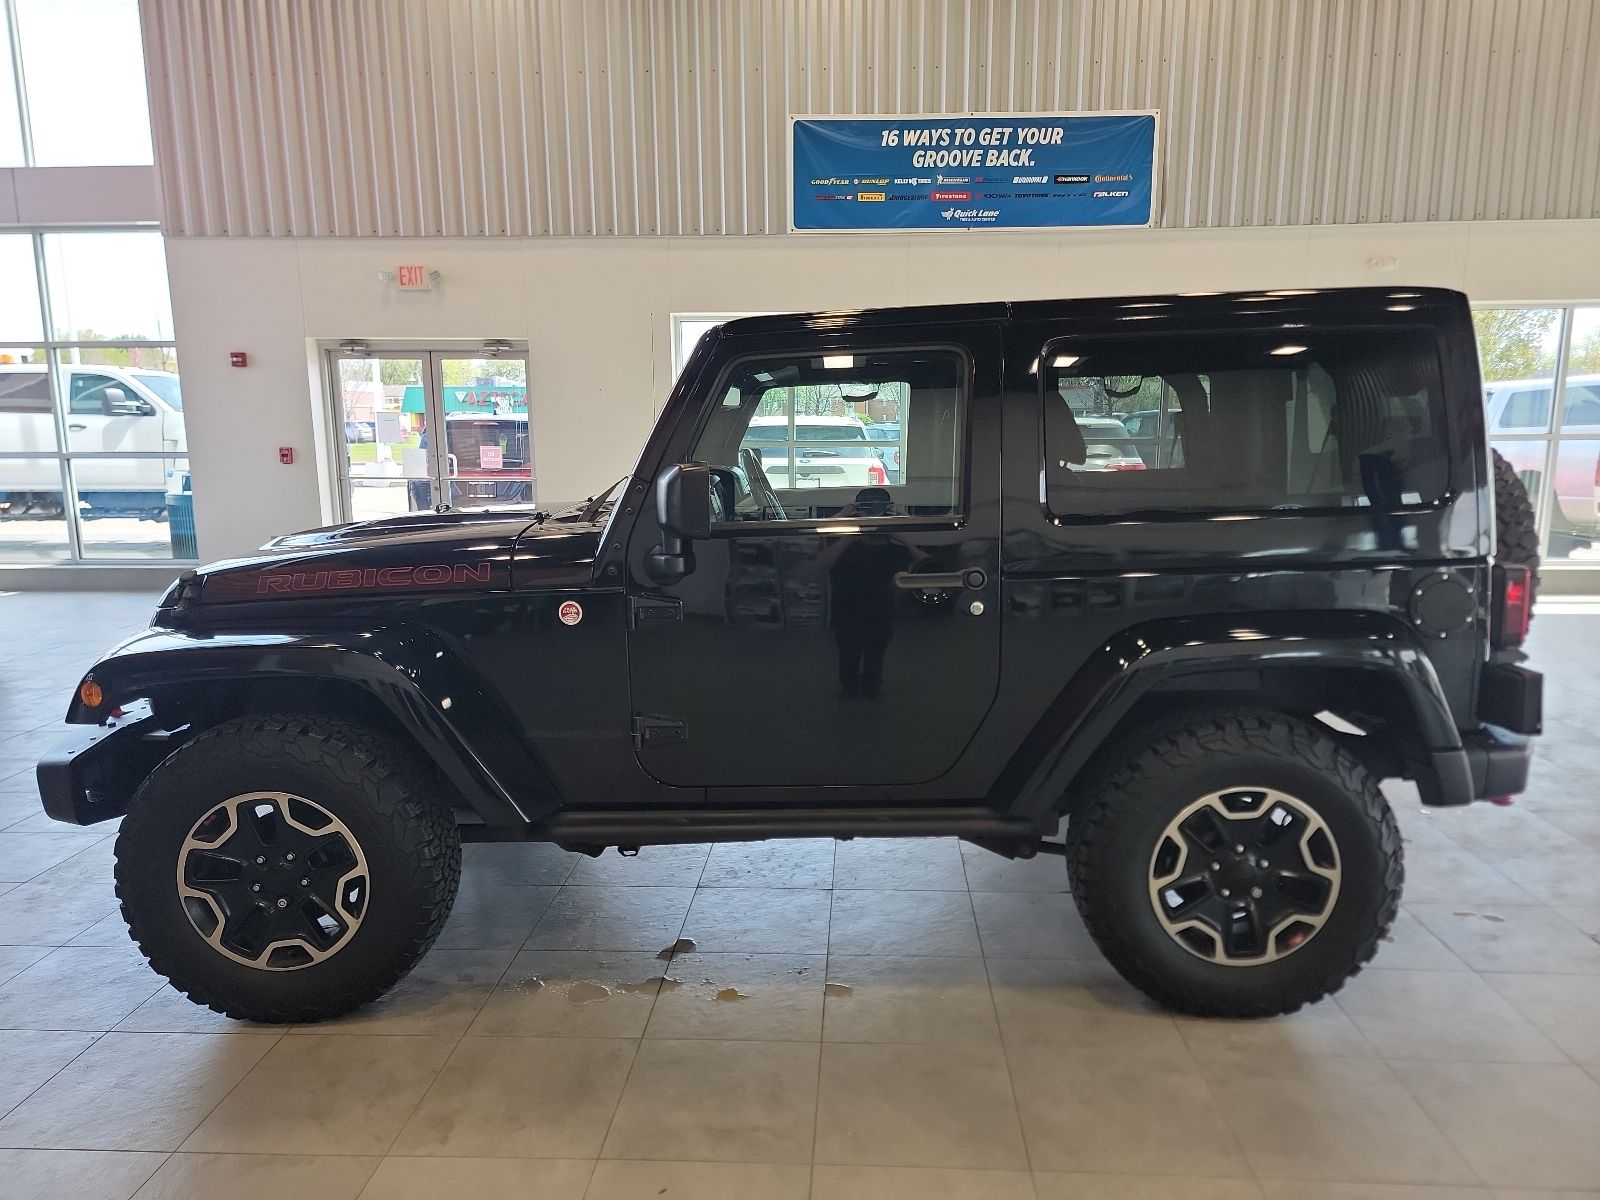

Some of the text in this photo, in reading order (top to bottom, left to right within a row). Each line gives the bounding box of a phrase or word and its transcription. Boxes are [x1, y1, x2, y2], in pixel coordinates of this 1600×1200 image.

[881, 127, 1064, 147] 16 WAYS TO GET YOUR
[912, 149, 1035, 168] GROOVE BACK.
[811, 178, 850, 186] GOODYEAR
[1094, 175, 1128, 183] Continental
[953, 209, 1000, 218] Quick Lane
[399, 266, 424, 286] EXIT
[256, 562, 492, 594] RUBICON
